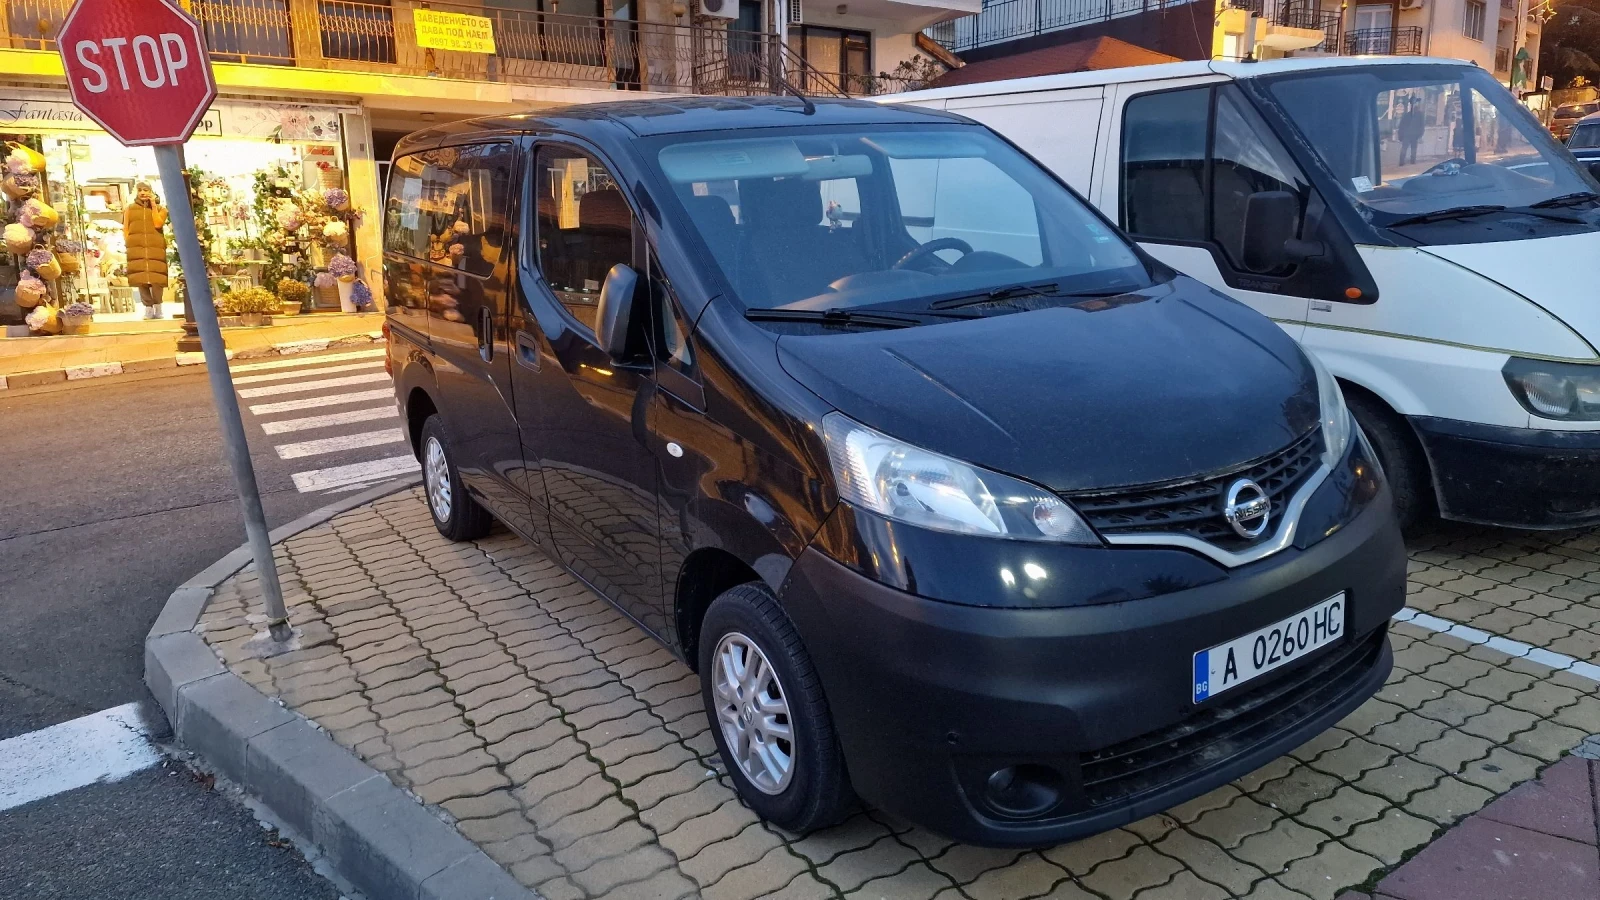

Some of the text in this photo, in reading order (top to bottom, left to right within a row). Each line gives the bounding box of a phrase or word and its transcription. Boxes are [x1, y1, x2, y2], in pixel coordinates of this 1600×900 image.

[417, 13, 490, 29] ЗАВЕДЕНИЕТО СЕ
[421, 26, 488, 39] ДАВА ПОД НАЕМ
[429, 37, 448, 46] 0897
[75, 33, 188, 93] STOP
[0, 103, 83, 125] Fantasia
[1234, 502, 1270, 519] NISSAN
[1223, 601, 1341, 685] A 0260 HC
[1195, 680, 1208, 695] BG
